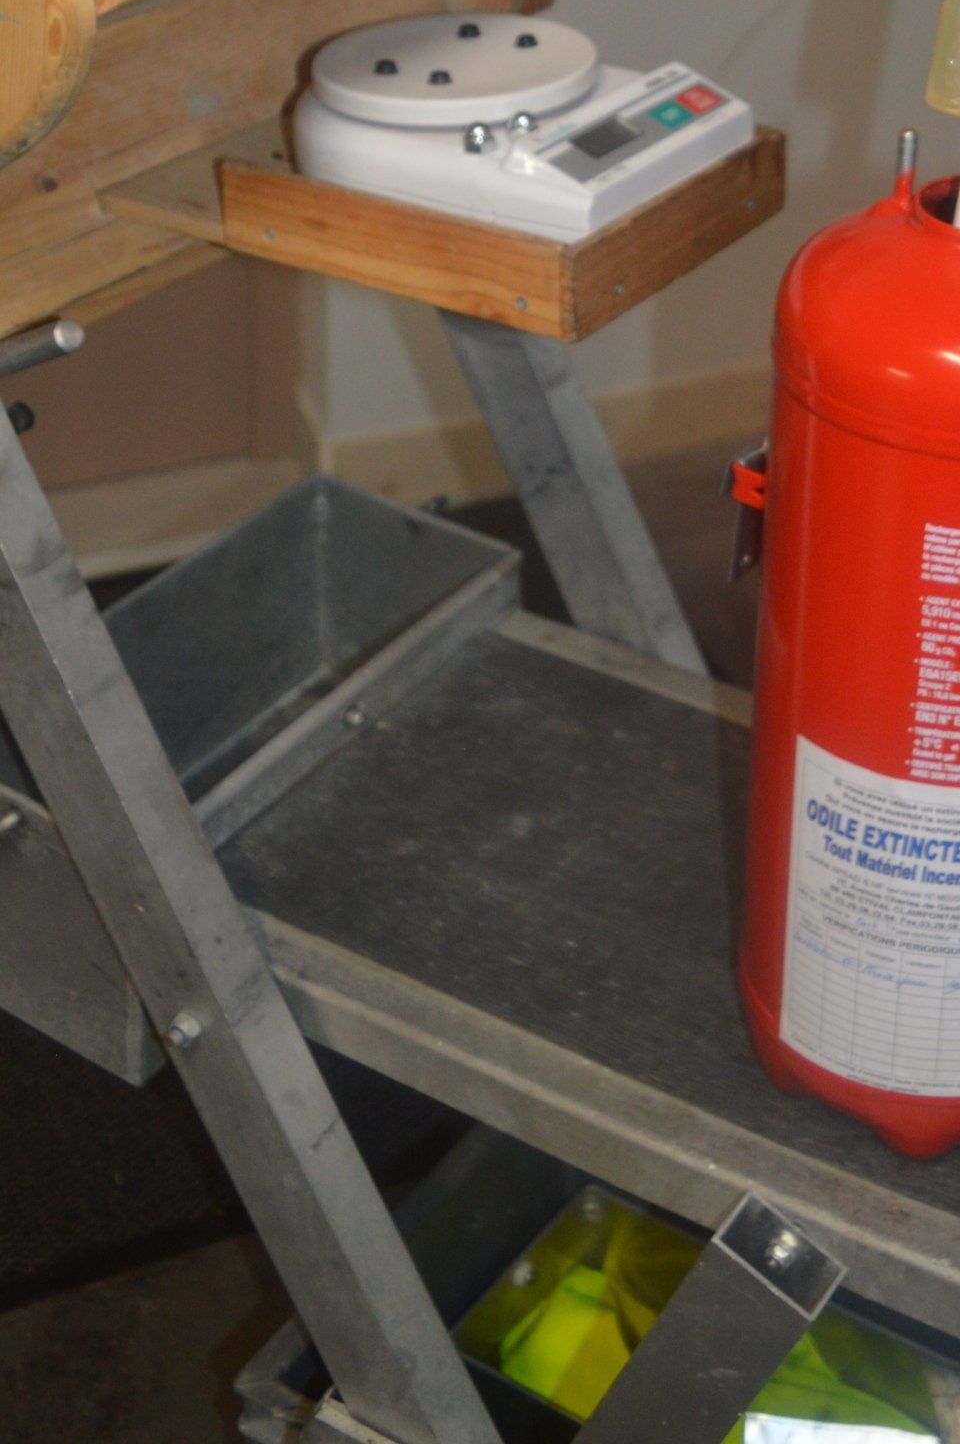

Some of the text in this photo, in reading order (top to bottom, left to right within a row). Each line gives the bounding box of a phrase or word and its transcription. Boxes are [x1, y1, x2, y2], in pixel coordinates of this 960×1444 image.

[806, 798, 858, 842] ODILE
[823, 834, 853, 863] Tout
[855, 850, 917, 882] Matériel
